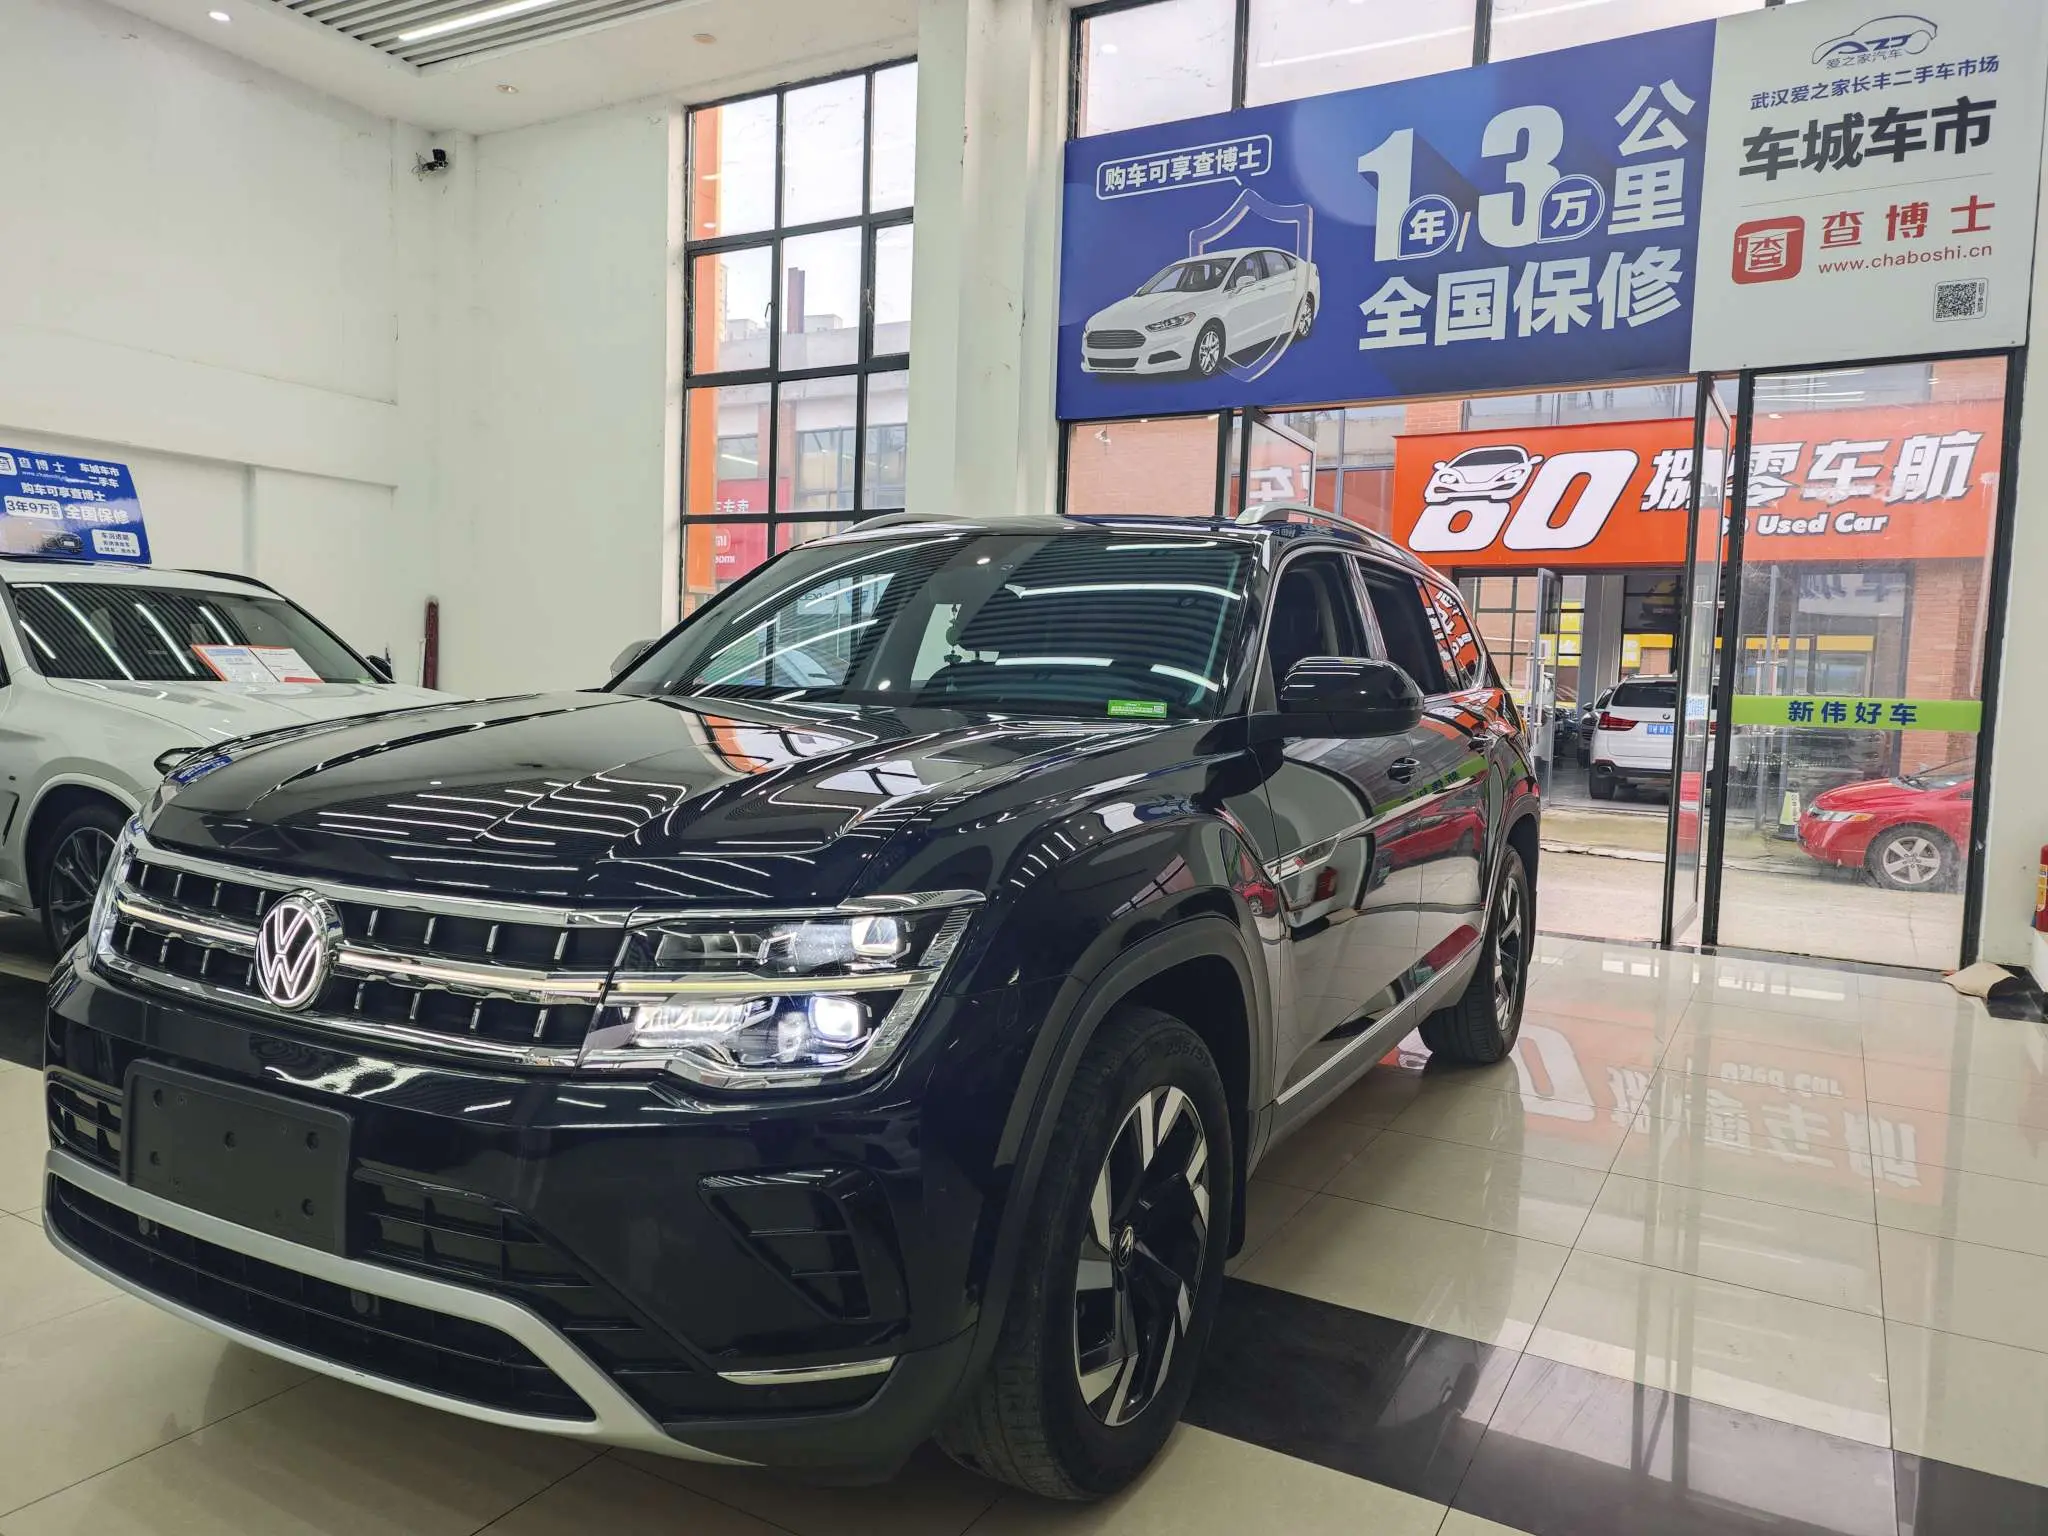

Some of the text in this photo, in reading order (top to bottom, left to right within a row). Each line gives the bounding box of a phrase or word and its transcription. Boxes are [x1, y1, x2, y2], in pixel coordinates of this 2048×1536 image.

[1749, 54, 2000, 110] 武汉爱之家长丰二手车市场
[1826, 48, 1903, 69] 爱之家汽车
[1608, 78, 1696, 236] 公里
[1739, 96, 1998, 182] 车城车市
[1104, 143, 1262, 191] 购车可享查博士
[1819, 194, 1996, 250] 查博士
[1818, 243, 1993, 274] www.chaboshi.cn
[1358, 245, 1684, 352] 全国保修
[64, 504, 129, 525] 全国保修
[1757, 512, 1829, 536] Used
[1835, 511, 1889, 534] Car
[1787, 699, 1919, 727] 新伟好车
